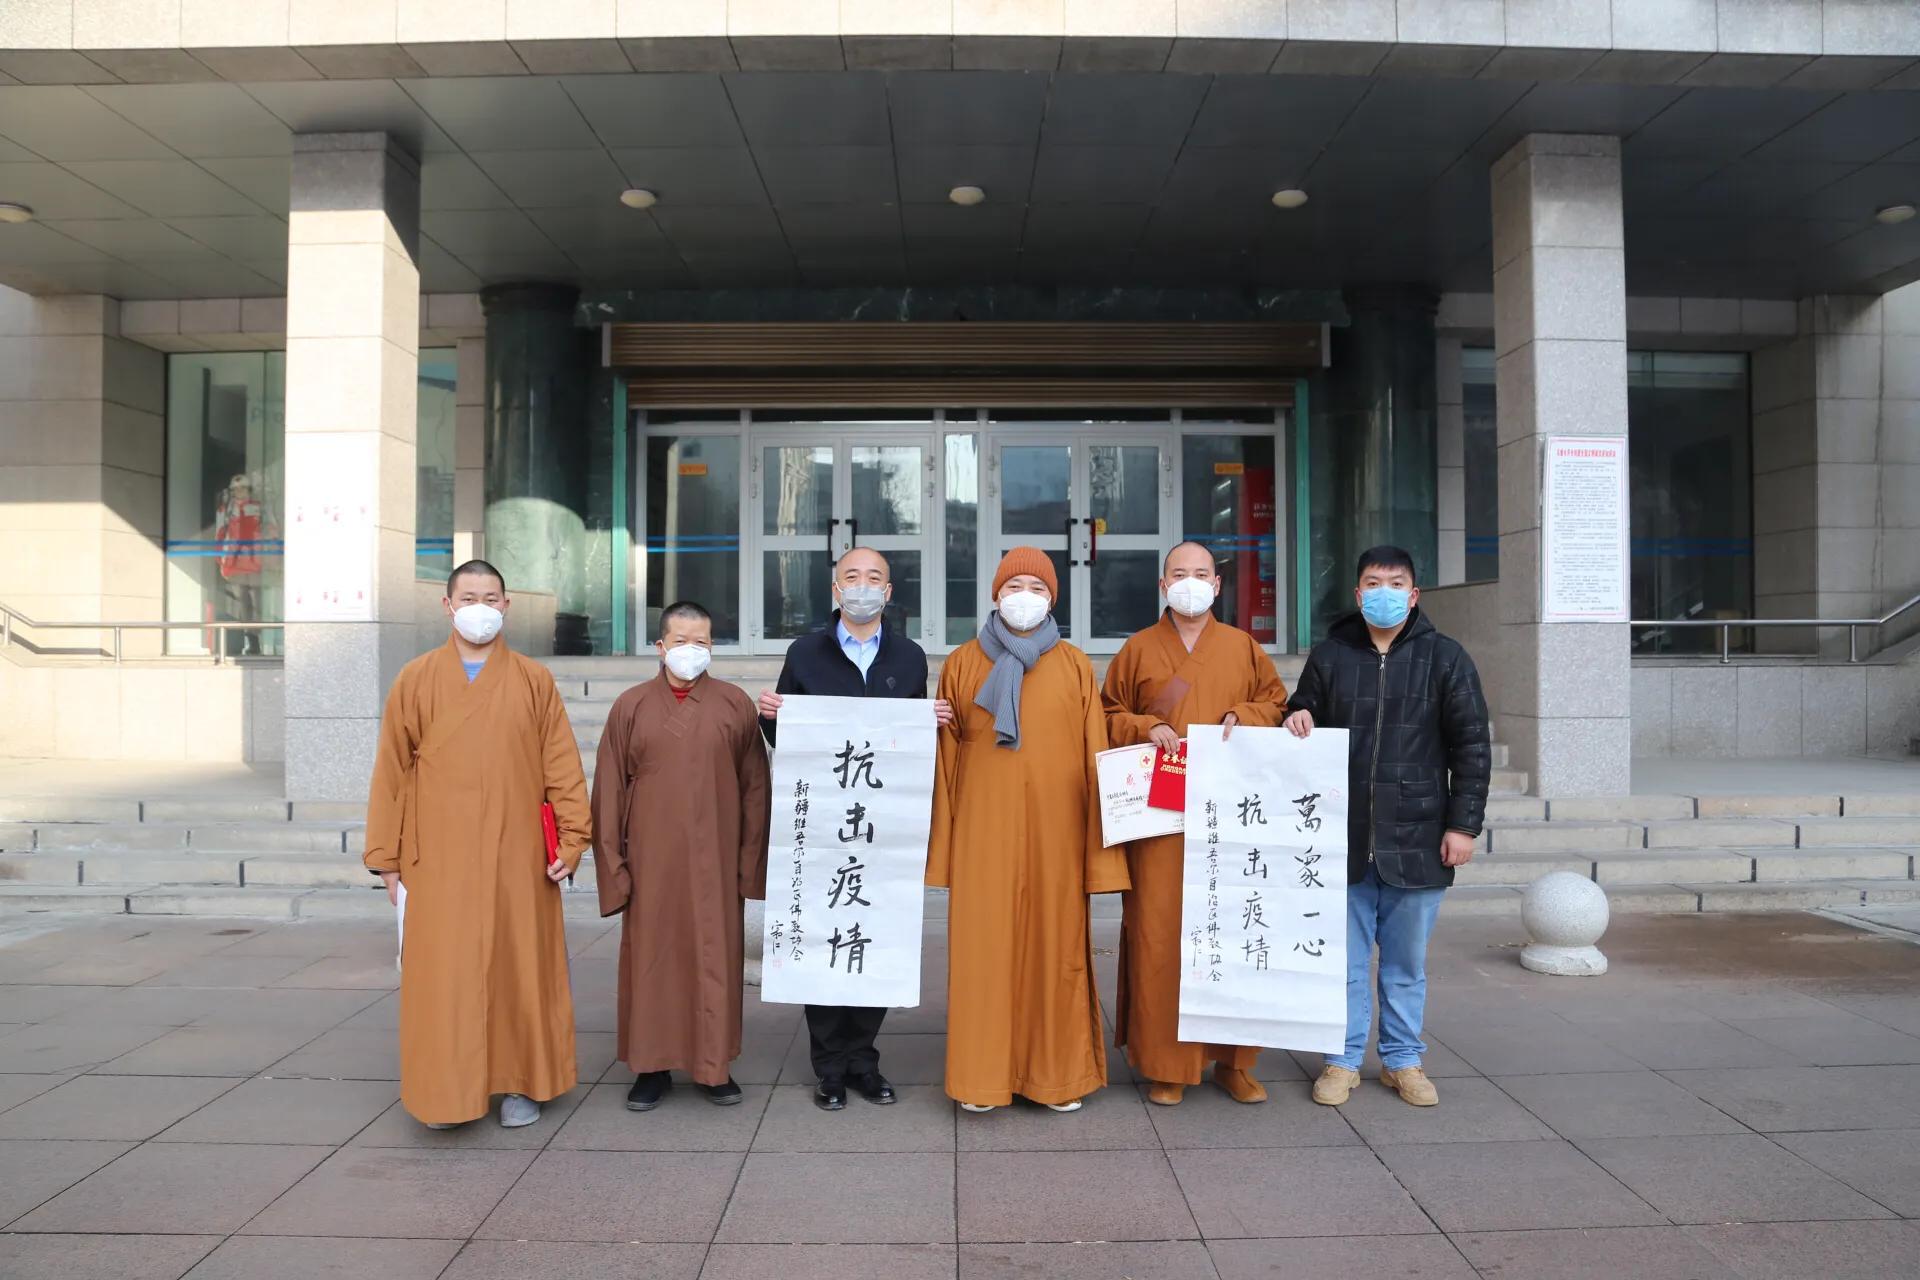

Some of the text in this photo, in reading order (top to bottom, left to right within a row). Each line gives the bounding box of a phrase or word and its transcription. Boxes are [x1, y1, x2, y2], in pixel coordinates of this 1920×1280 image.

[827, 740, 883, 973] 抗击疫情
[1237, 793, 1271, 971] 抗击疫情
